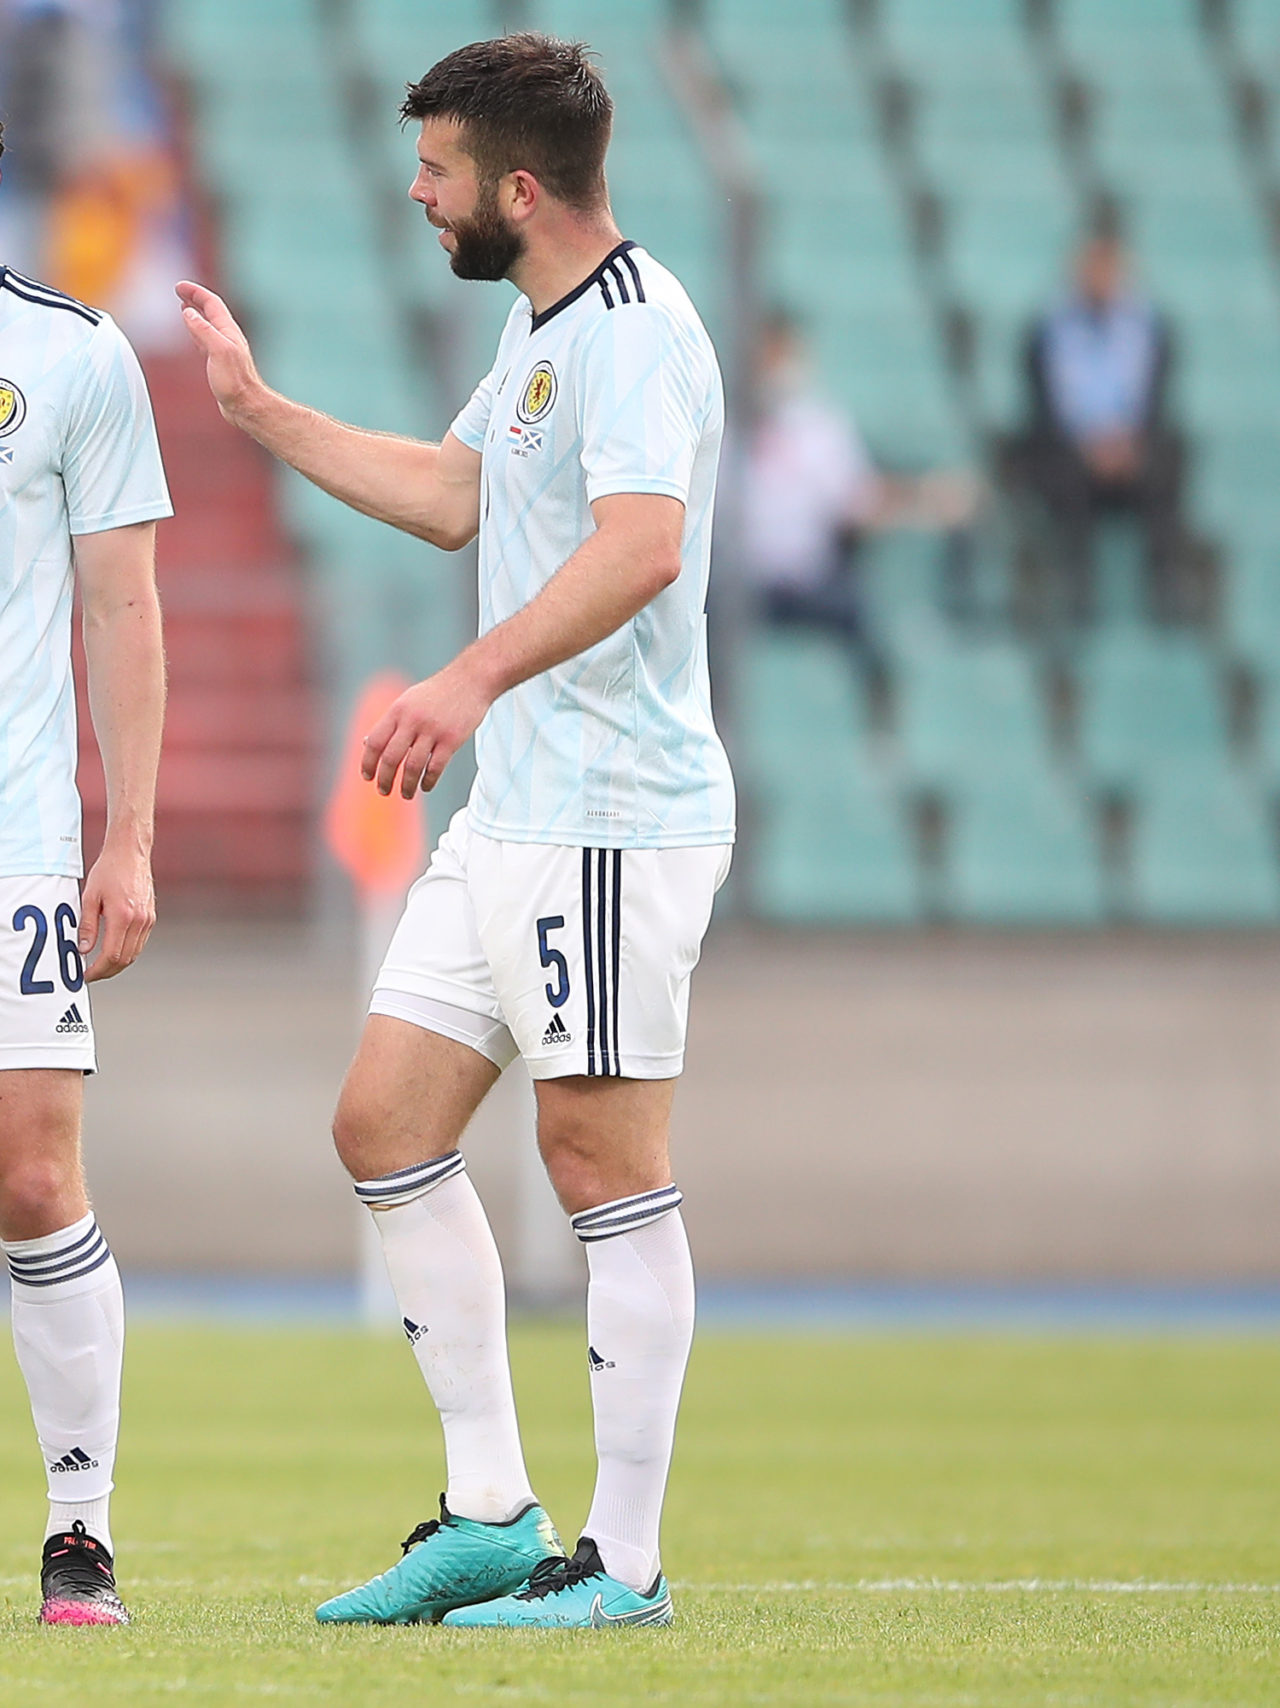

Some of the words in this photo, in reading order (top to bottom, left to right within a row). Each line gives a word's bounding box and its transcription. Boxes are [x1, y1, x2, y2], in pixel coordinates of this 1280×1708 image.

[12, 902, 84, 994] 26
[536, 915, 570, 1008] 5
[55, 1022, 89, 1033] adidas
[541, 1031, 572, 1046] adidas
[50, 1460, 99, 1472] adidas
